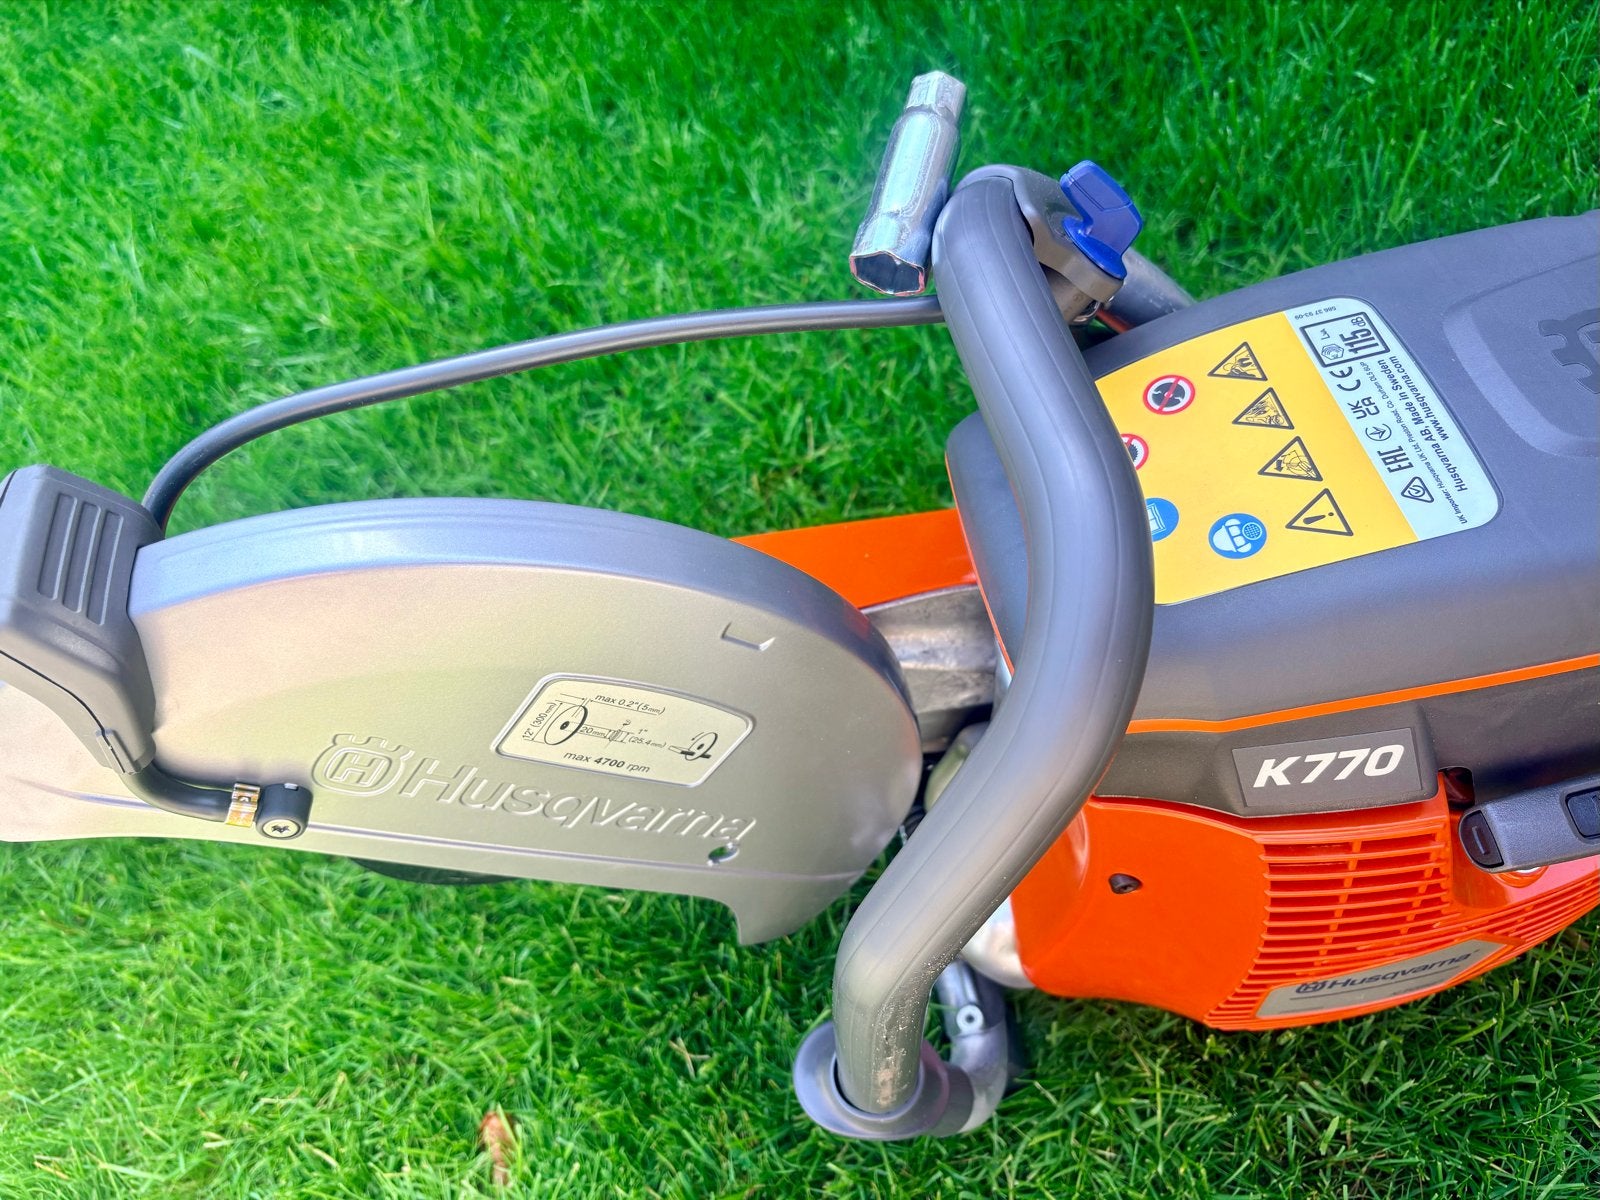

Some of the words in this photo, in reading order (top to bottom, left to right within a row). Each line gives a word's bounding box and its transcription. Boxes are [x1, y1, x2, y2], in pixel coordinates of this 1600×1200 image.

[1350, 316, 1366, 327] dB
[1339, 328, 1379, 354] 115
[1377, 359, 1402, 391] Sweden
[1389, 355, 1449, 441] www.husqvarna.com
[1398, 391, 1409, 401] in
[1347, 400, 1367, 420] UK
[1405, 401, 1425, 426] Made
[1420, 425, 1437, 442] AB,
[1420, 452, 1428, 462] UK
[1431, 443, 1468, 492] Husqvarna
[1424, 461, 1445, 489] Husqvarna
[1457, 514, 1468, 524] UK
[594, 694, 617, 705] max
[563, 752, 592, 763] max
[594, 756, 626, 768] 4700
[626, 763, 651, 773] rpm
[400, 755, 758, 842] Husqvarna
[1327, 952, 1472, 990] Husqvarna
